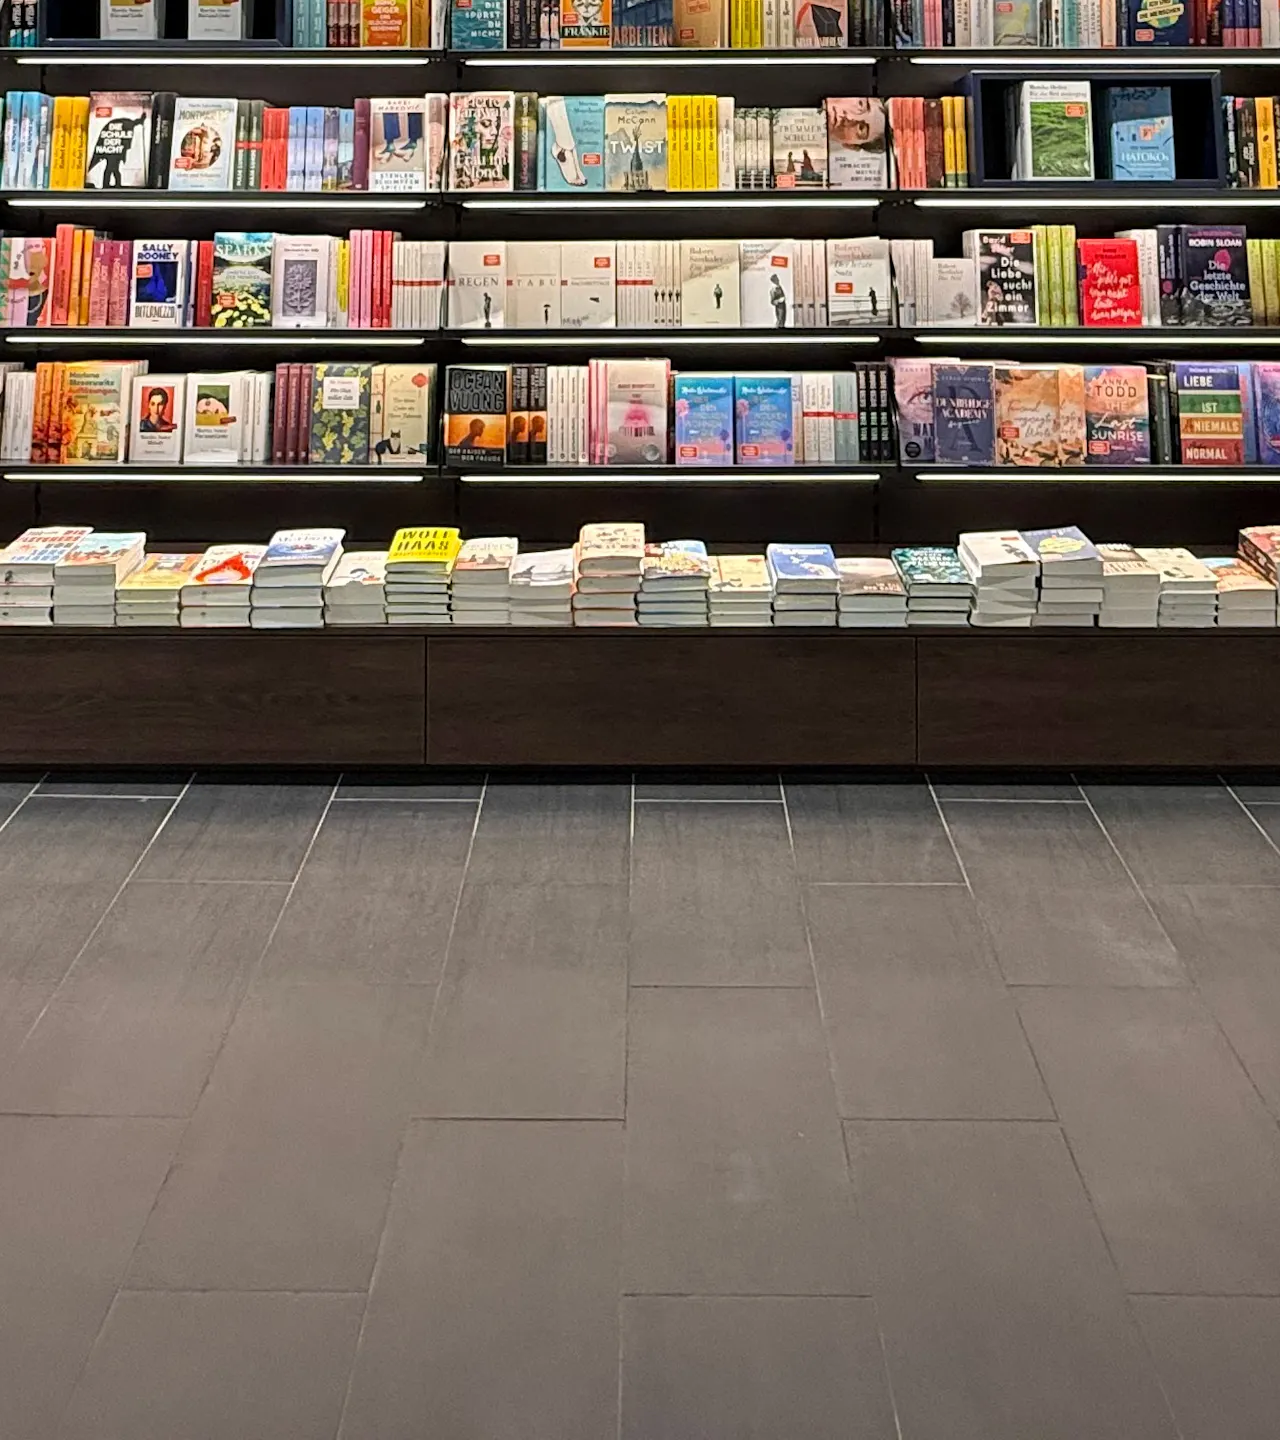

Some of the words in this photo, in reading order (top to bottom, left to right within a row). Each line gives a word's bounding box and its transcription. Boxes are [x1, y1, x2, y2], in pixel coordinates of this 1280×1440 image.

[563, 26, 610, 37] FRANKIE
[108, 123, 124, 132] DIE
[101, 130, 133, 140] SCHULE
[104, 139, 121, 147] DER
[610, 140, 665, 155] TWIST
[96, 145, 124, 154] NACHT
[1188, 239, 1212, 247] ROBIN
[1216, 239, 1242, 247] SLOAN
[142, 244, 174, 253] SALLY
[217, 243, 271, 256] SPARKS
[137, 251, 180, 260] ROONEY
[1000, 258, 1020, 268] Die
[1208, 260, 1226, 271] Die
[991, 269, 1022, 279] Liebe
[1203, 271, 1232, 281] letzte
[458, 277, 499, 287] REGEN
[1002, 281, 1032, 291] sucht
[1190, 281, 1246, 292] Geschichte
[1218, 291, 1240, 301] Welt
[450, 372, 504, 392] OCEAN
[1184, 375, 1213, 388] LIEBE
[1096, 385, 1137, 398] TODD
[450, 392, 504, 409] VUONG
[1202, 402, 1217, 413] IST
[1194, 418, 1239, 432] NIEMALS
[1091, 430, 1144, 442] SUNRISE
[1186, 446, 1227, 460] NORMAL
